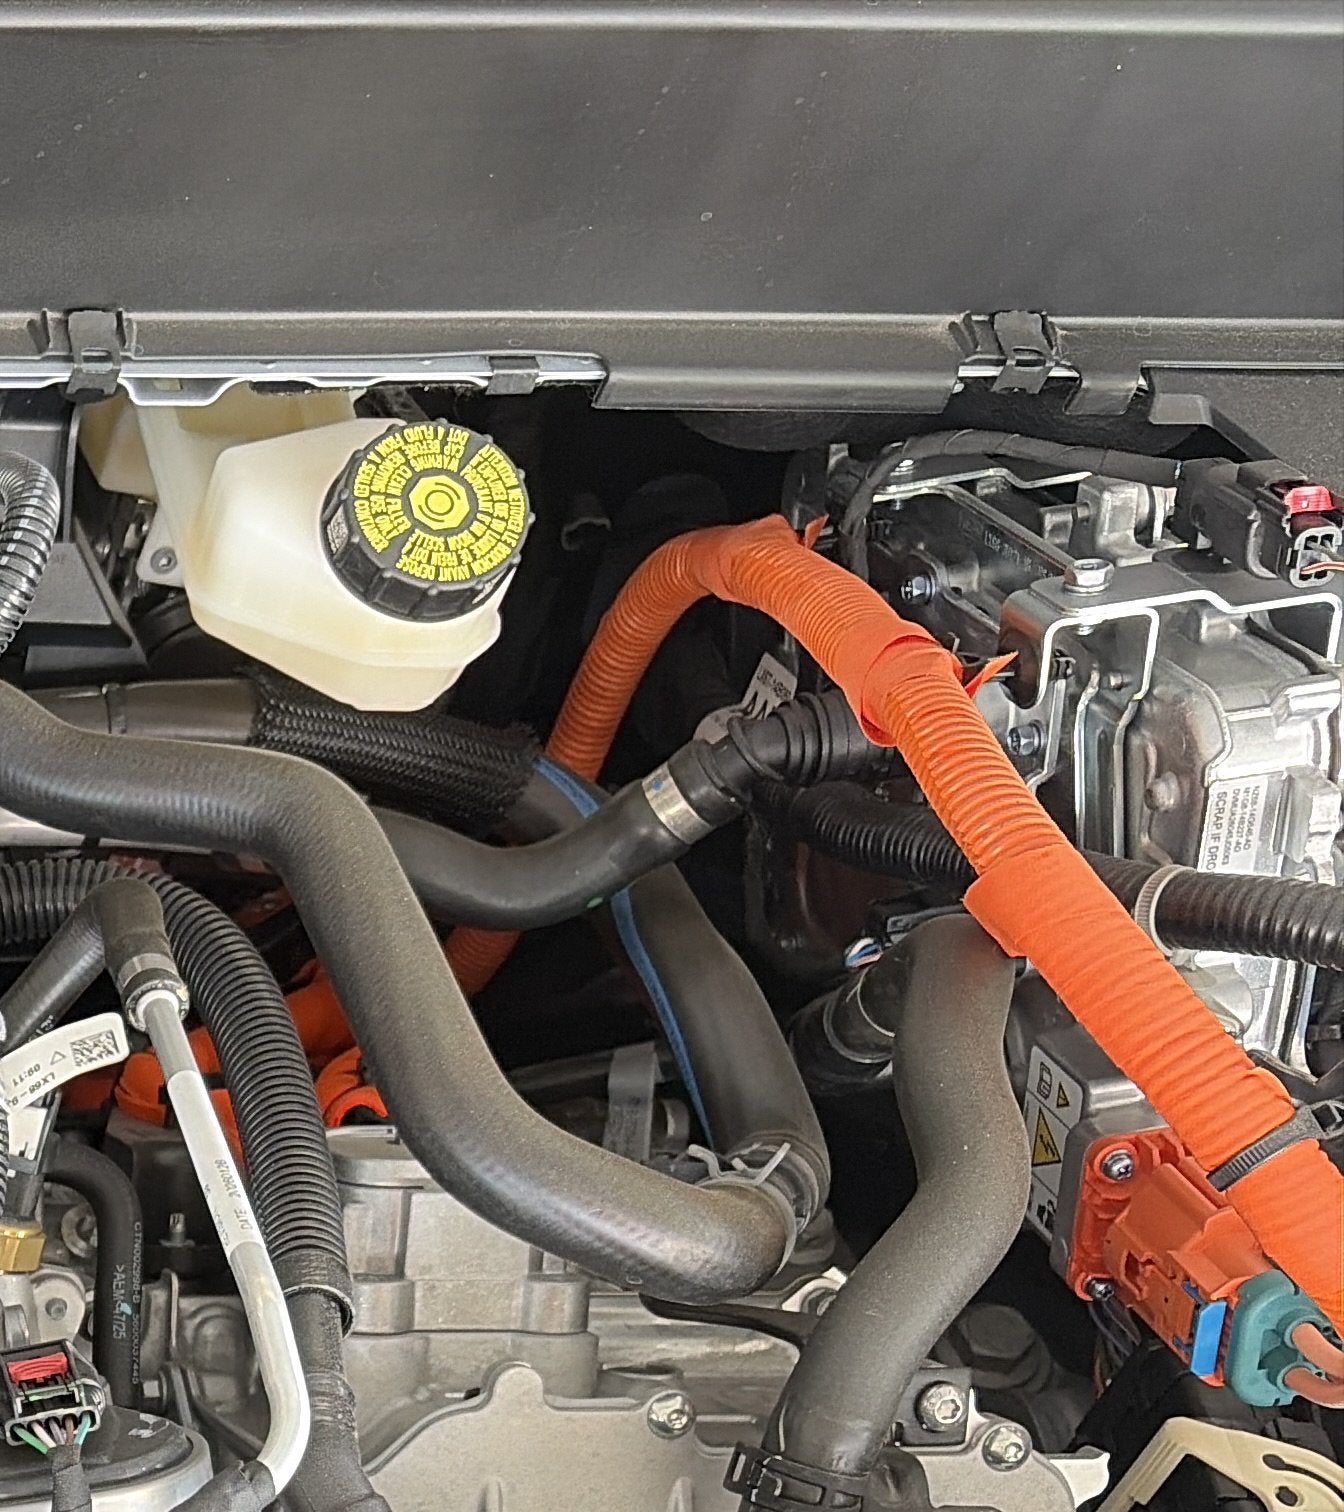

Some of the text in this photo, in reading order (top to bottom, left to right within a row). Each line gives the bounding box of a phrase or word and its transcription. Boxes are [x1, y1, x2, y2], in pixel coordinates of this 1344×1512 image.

[404, 425, 434, 441] FLUID
[447, 428, 469, 445] DOT
[375, 433, 405, 457] FROM
[402, 440, 441, 459] BEFORE
[443, 442, 465, 459] CAP
[367, 451, 382, 464] A
[354, 460, 376, 497] SEALED
[371, 450, 406, 493] REMOVING
[369, 495, 386, 513] USE
[386, 454, 460, 534] WARNING CLEAN FILLER
[396, 444, 524, 582] ATTENTION NETTOYER LE BOUCHON AVANT DEPOSE
[354, 500, 389, 553] CONTAINER
[411, 547, 429, 563] DOT
[431, 551, 458, 566] FREIN
[1205, 791, 1228, 871] SCRAP IF DRO
[233, 1206, 254, 1230] DATE
